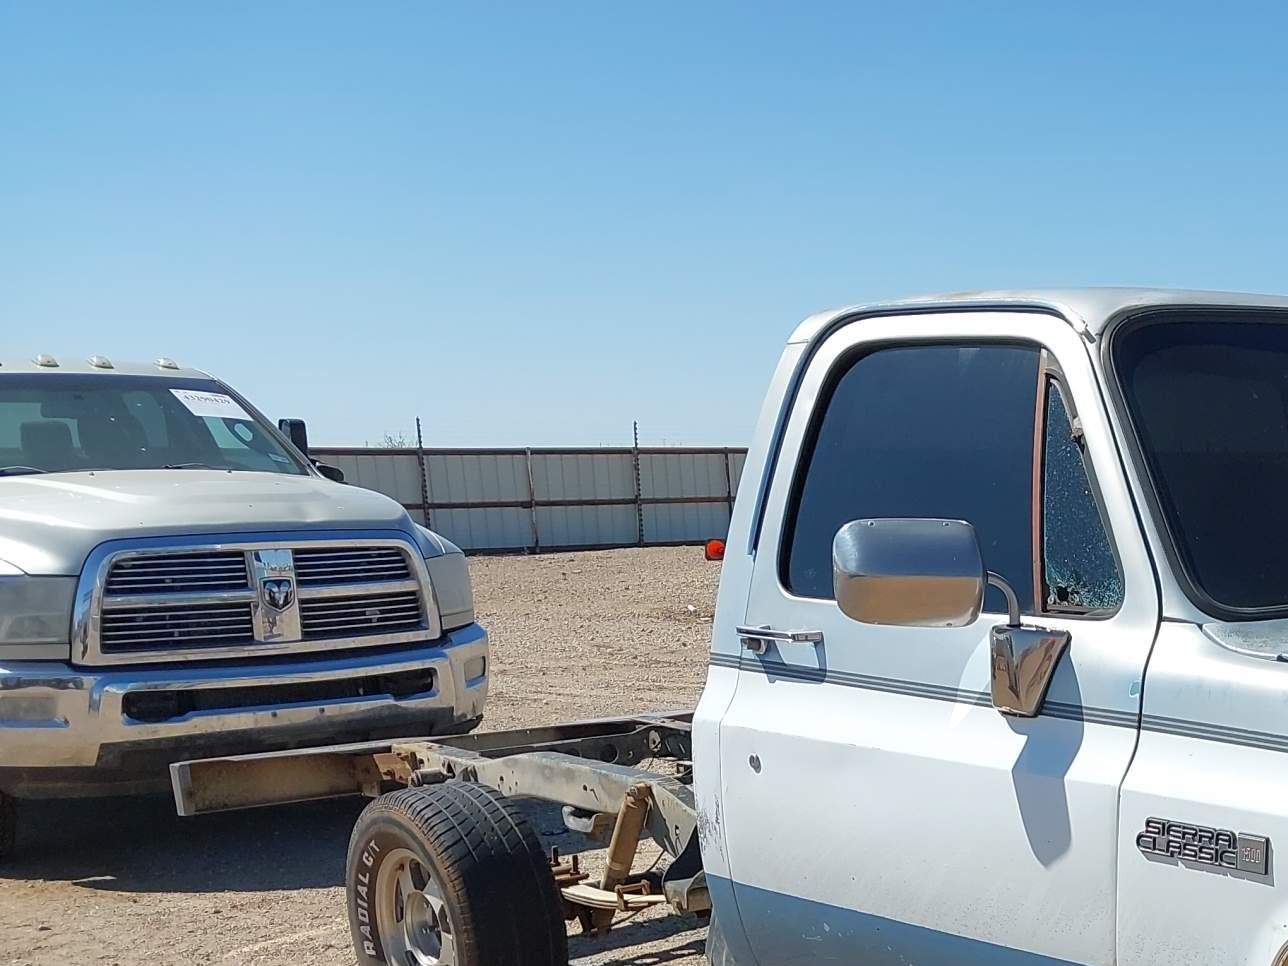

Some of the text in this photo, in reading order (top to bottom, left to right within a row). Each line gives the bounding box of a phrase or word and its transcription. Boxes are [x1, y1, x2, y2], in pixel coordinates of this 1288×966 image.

[1136, 832, 1237, 868] CLASSIC
[1145, 817, 1237, 849] SIERRA
[357, 839, 381, 956] RADIAL C/T
